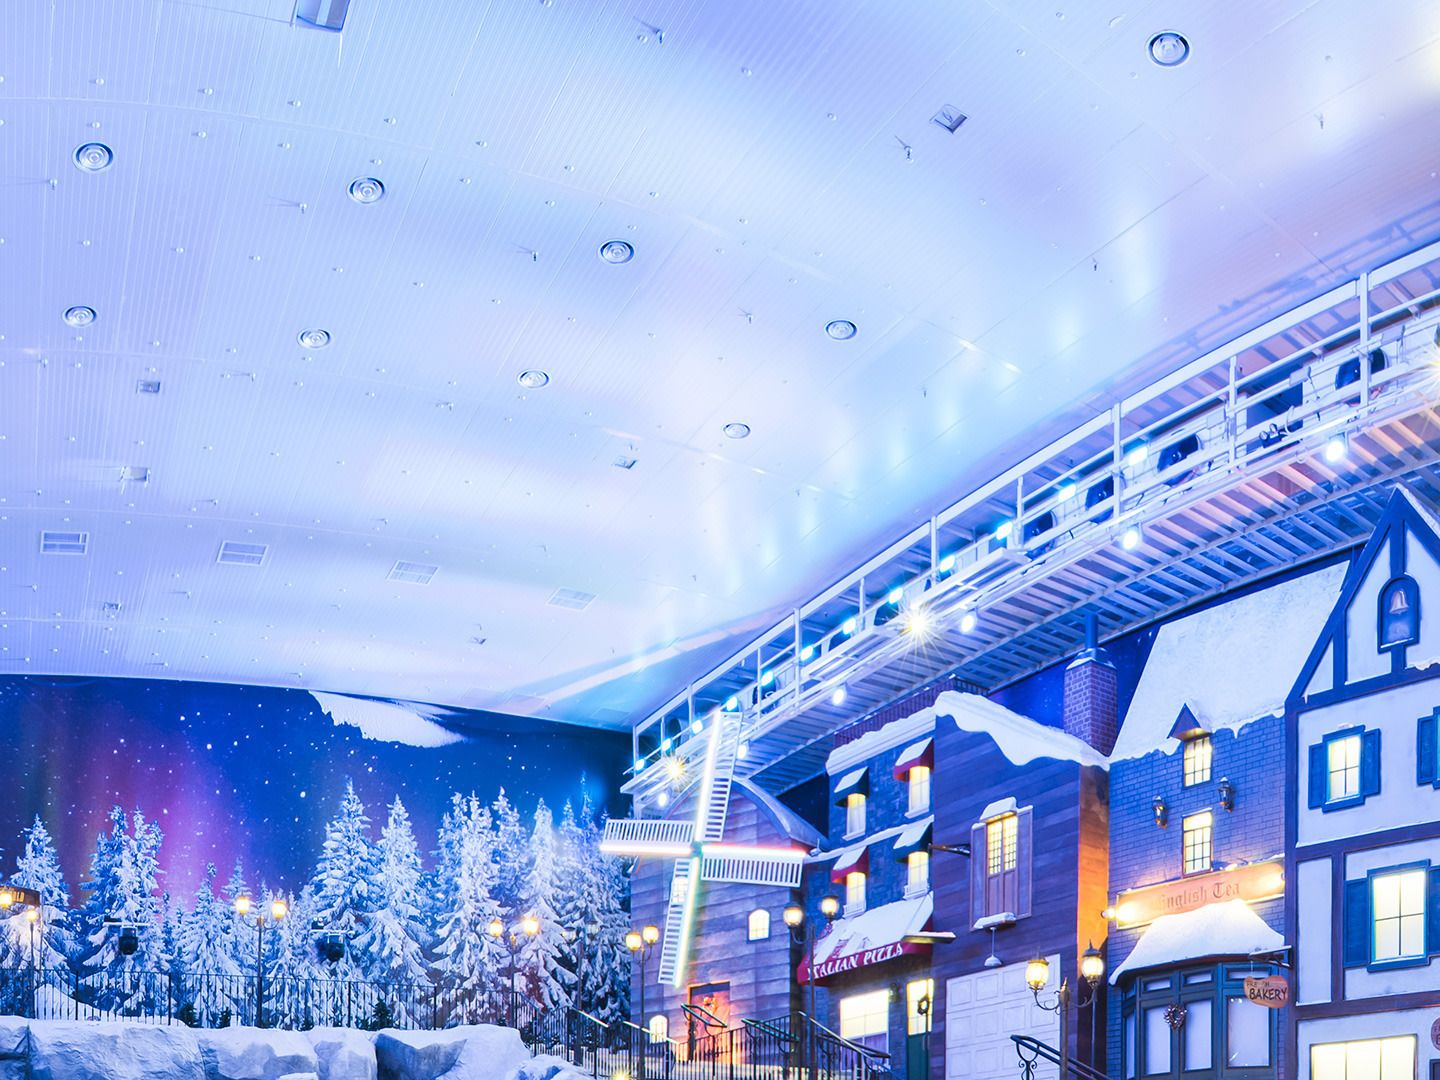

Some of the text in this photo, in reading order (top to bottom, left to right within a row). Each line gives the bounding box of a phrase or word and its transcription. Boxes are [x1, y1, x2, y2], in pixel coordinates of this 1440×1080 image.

[1212, 883, 1240, 899] Tea
[863, 942, 904, 966] PIZZA
[1249, 987, 1288, 1001] BAKERY
